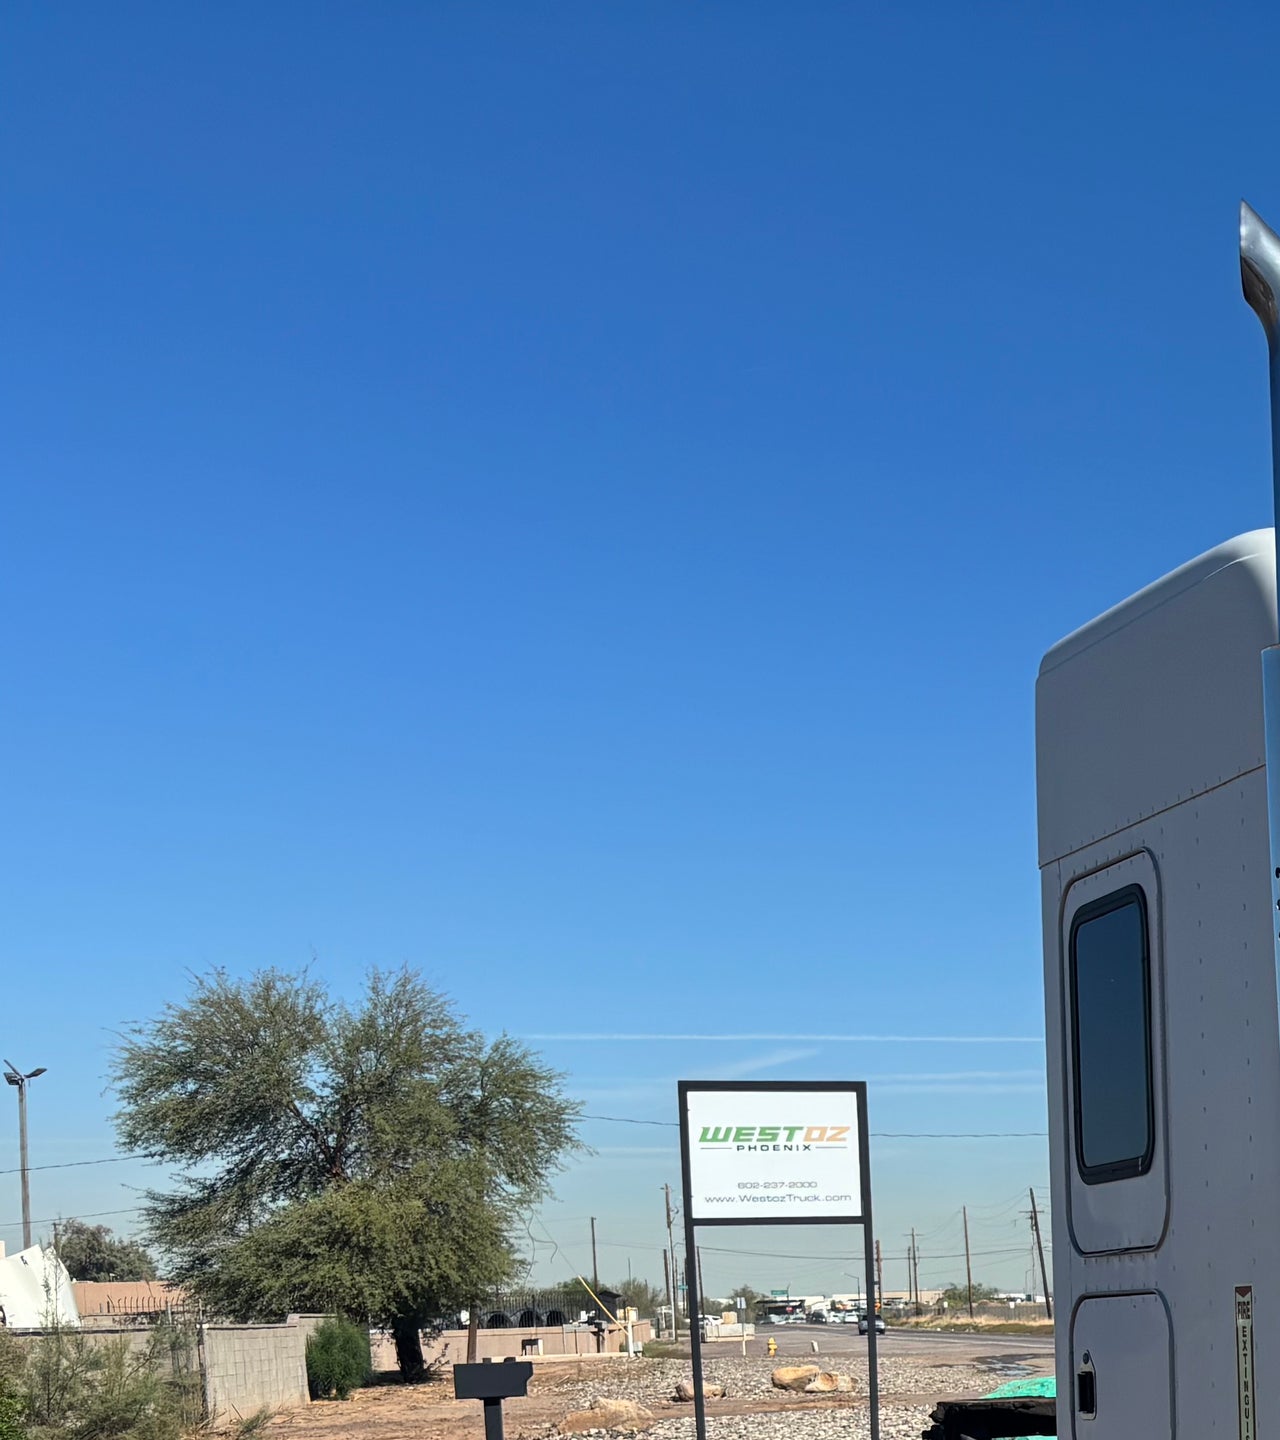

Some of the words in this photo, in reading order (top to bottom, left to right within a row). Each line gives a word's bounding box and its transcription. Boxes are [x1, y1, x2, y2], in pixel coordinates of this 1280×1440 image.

[698, 1126, 852, 1143] WESTOZ
[737, 1181, 818, 1190] 602-237-2000
[704, 1193, 852, 1204] www.WestozTruck.com
[1236, 1300, 1251, 1320] FIRE
